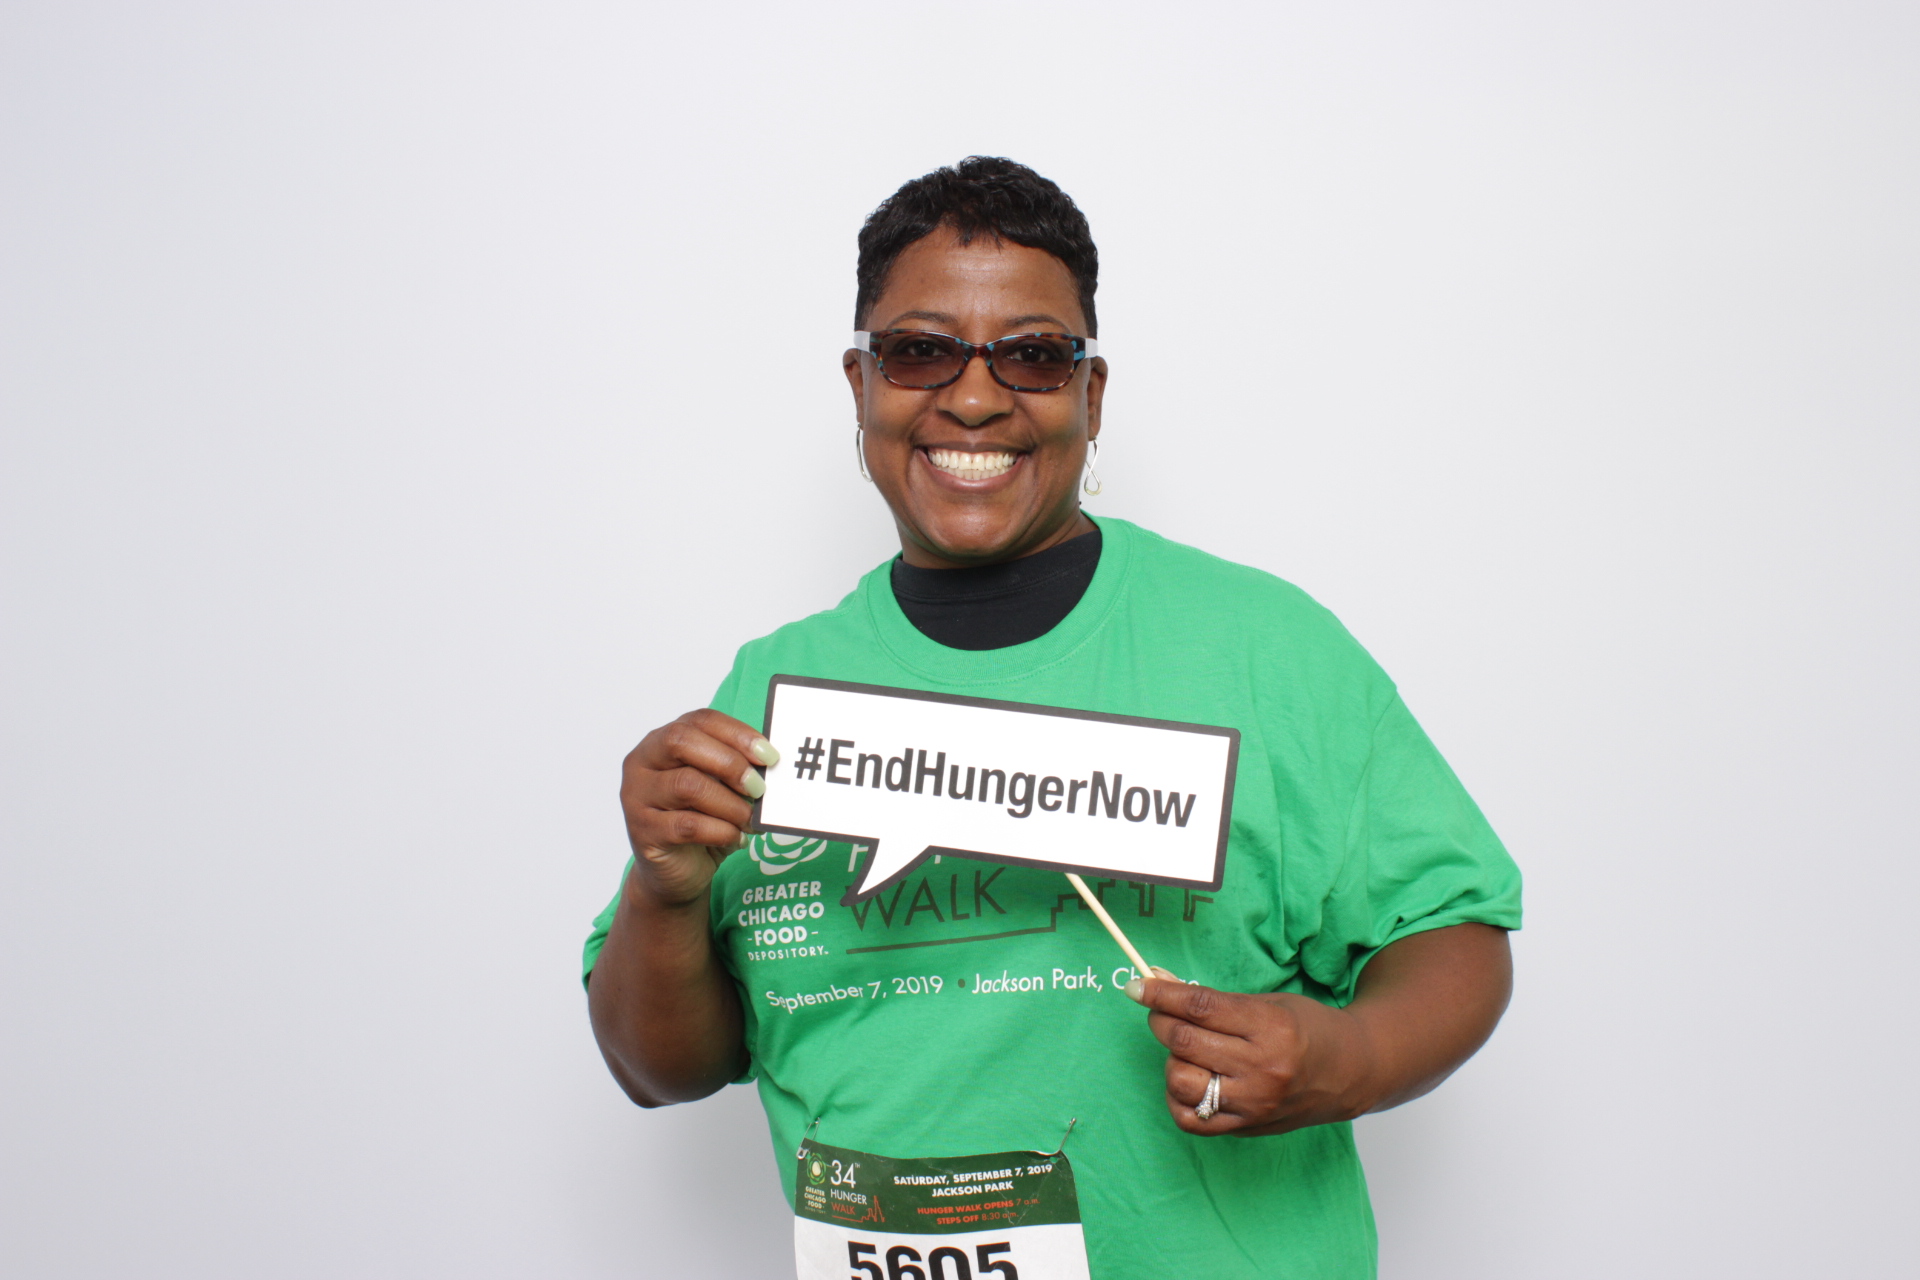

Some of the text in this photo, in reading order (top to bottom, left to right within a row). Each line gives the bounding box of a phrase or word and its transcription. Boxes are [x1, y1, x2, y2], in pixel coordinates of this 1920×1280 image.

[794, 736, 1196, 828] #EndHungerNow
[742, 881, 822, 905] GREATER
[845, 867, 1007, 931] WALK
[738, 902, 825, 927] CHICAGO
[765, 985, 864, 1014] September
[867, 981, 887, 999] 7,
[892, 975, 944, 995] 2019
[972, 970, 1045, 994] Jackson
[1052, 966, 1104, 992] Park,
[893, 1164, 1053, 1187] SATURDAY, SEPTEMBER 7, 2019
[804, 1192, 827, 1204] CHICAGO
[805, 1186, 826, 1197] GREATER
[830, 1188, 867, 1206] HUNGER
[931, 1180, 1015, 1198] JACKSON PARK
[831, 1202, 856, 1216] WALK
[917, 1197, 1041, 1215] HUNGER WALK OPENS 7 a.m.
[936, 1210, 1019, 1226] STEPS OFF 8:30 a.m.
